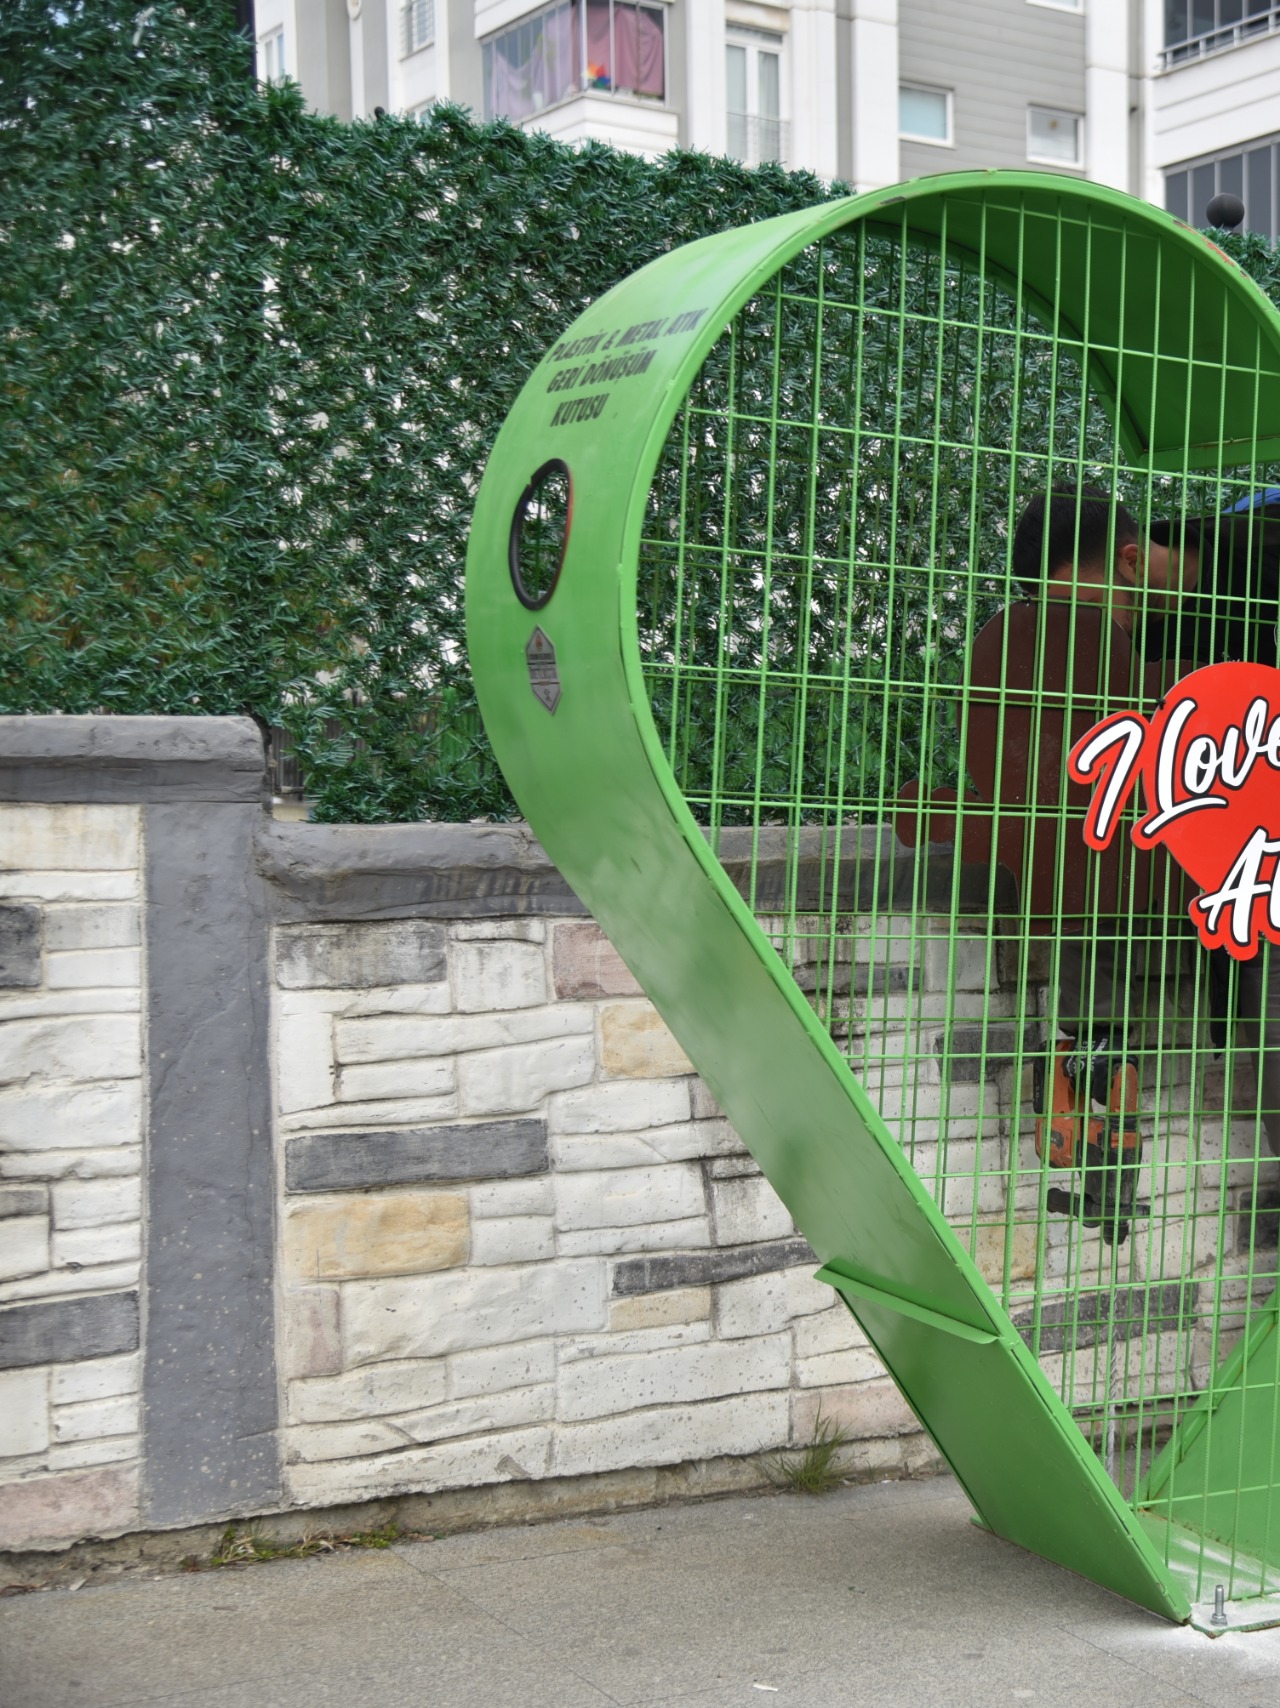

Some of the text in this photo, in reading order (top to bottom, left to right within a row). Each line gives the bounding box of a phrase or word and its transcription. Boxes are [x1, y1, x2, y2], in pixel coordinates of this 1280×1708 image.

[547, 329, 609, 362] PLASTİK
[615, 317, 670, 348] METAL
[663, 308, 708, 337] ATIK
[547, 346, 657, 393] GERİ DÖNÜŞÜM
[550, 393, 610, 427] KUTUSU
